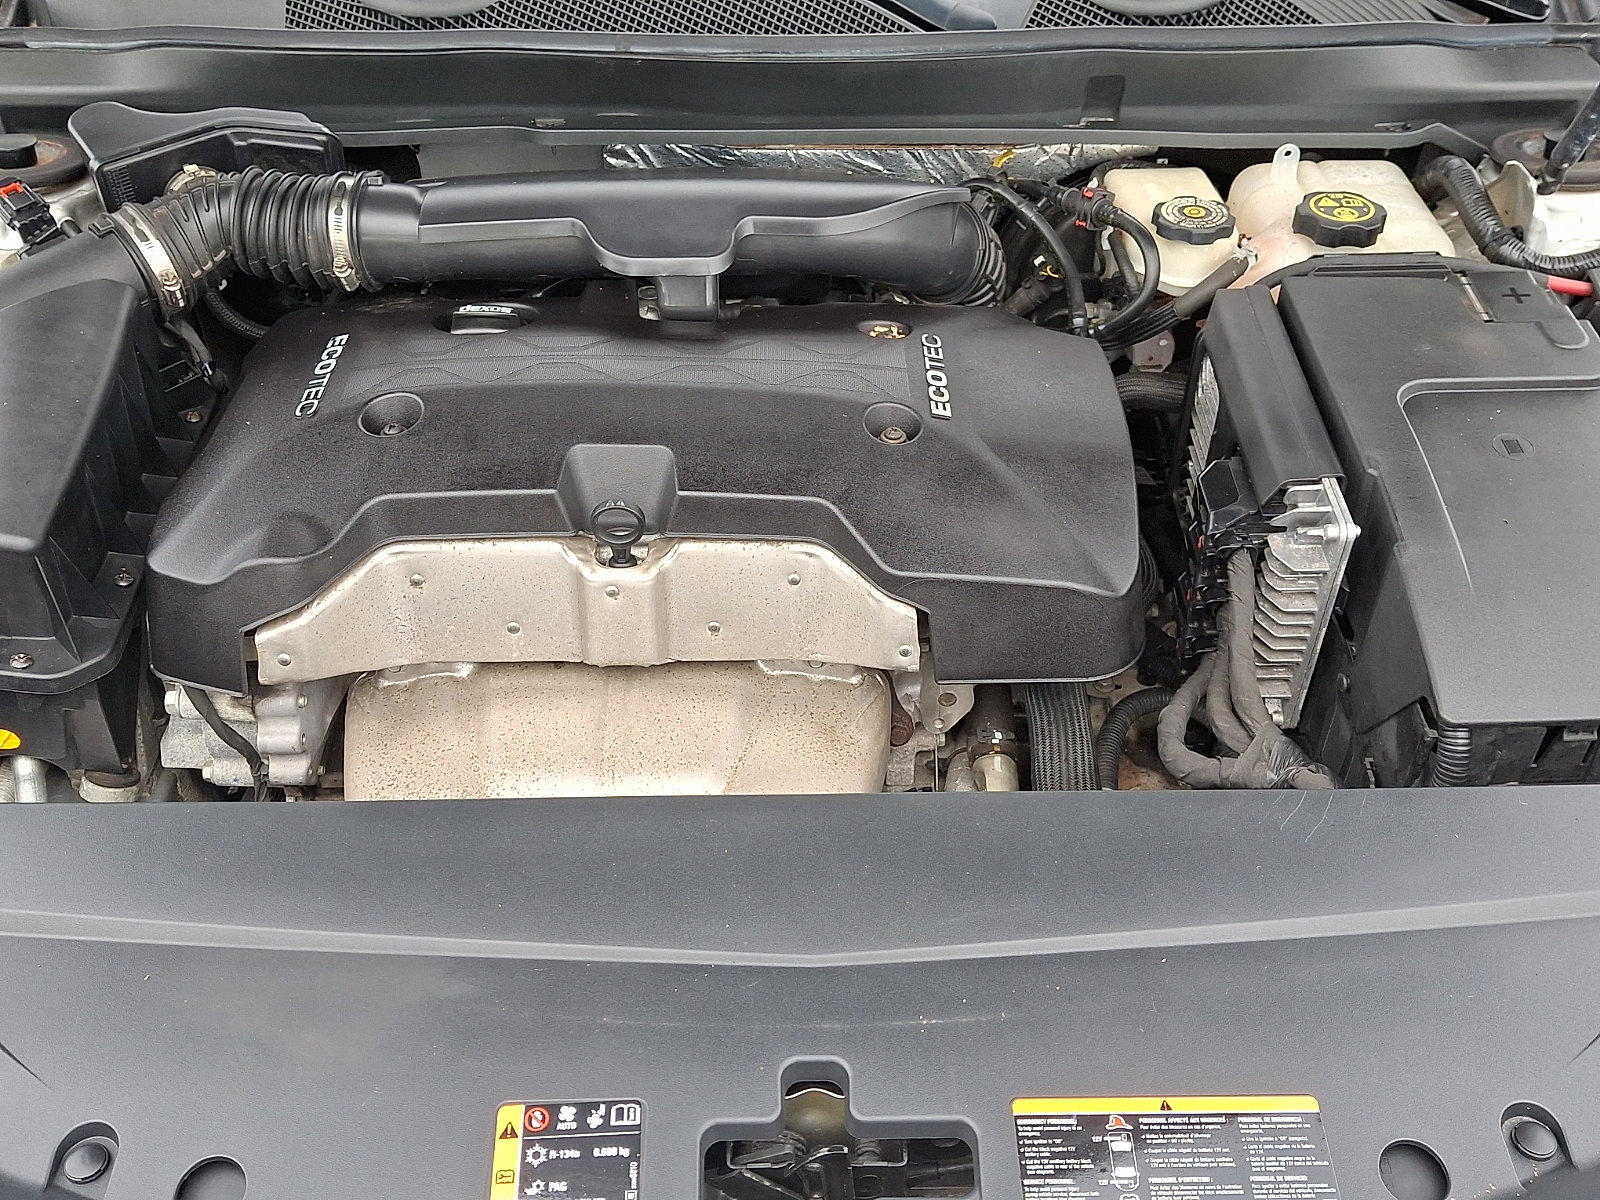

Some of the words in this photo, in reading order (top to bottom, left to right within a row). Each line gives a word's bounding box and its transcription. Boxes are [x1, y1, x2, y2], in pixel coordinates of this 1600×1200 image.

[458, 304, 514, 314] dexos
[294, 334, 350, 418] ECOTEC
[922, 334, 952, 418] ECOTEC
[556, 1122, 578, 1130] AUTO
[548, 1150, 580, 1158] R-134a
[548, 1182, 568, 1192] PAG
